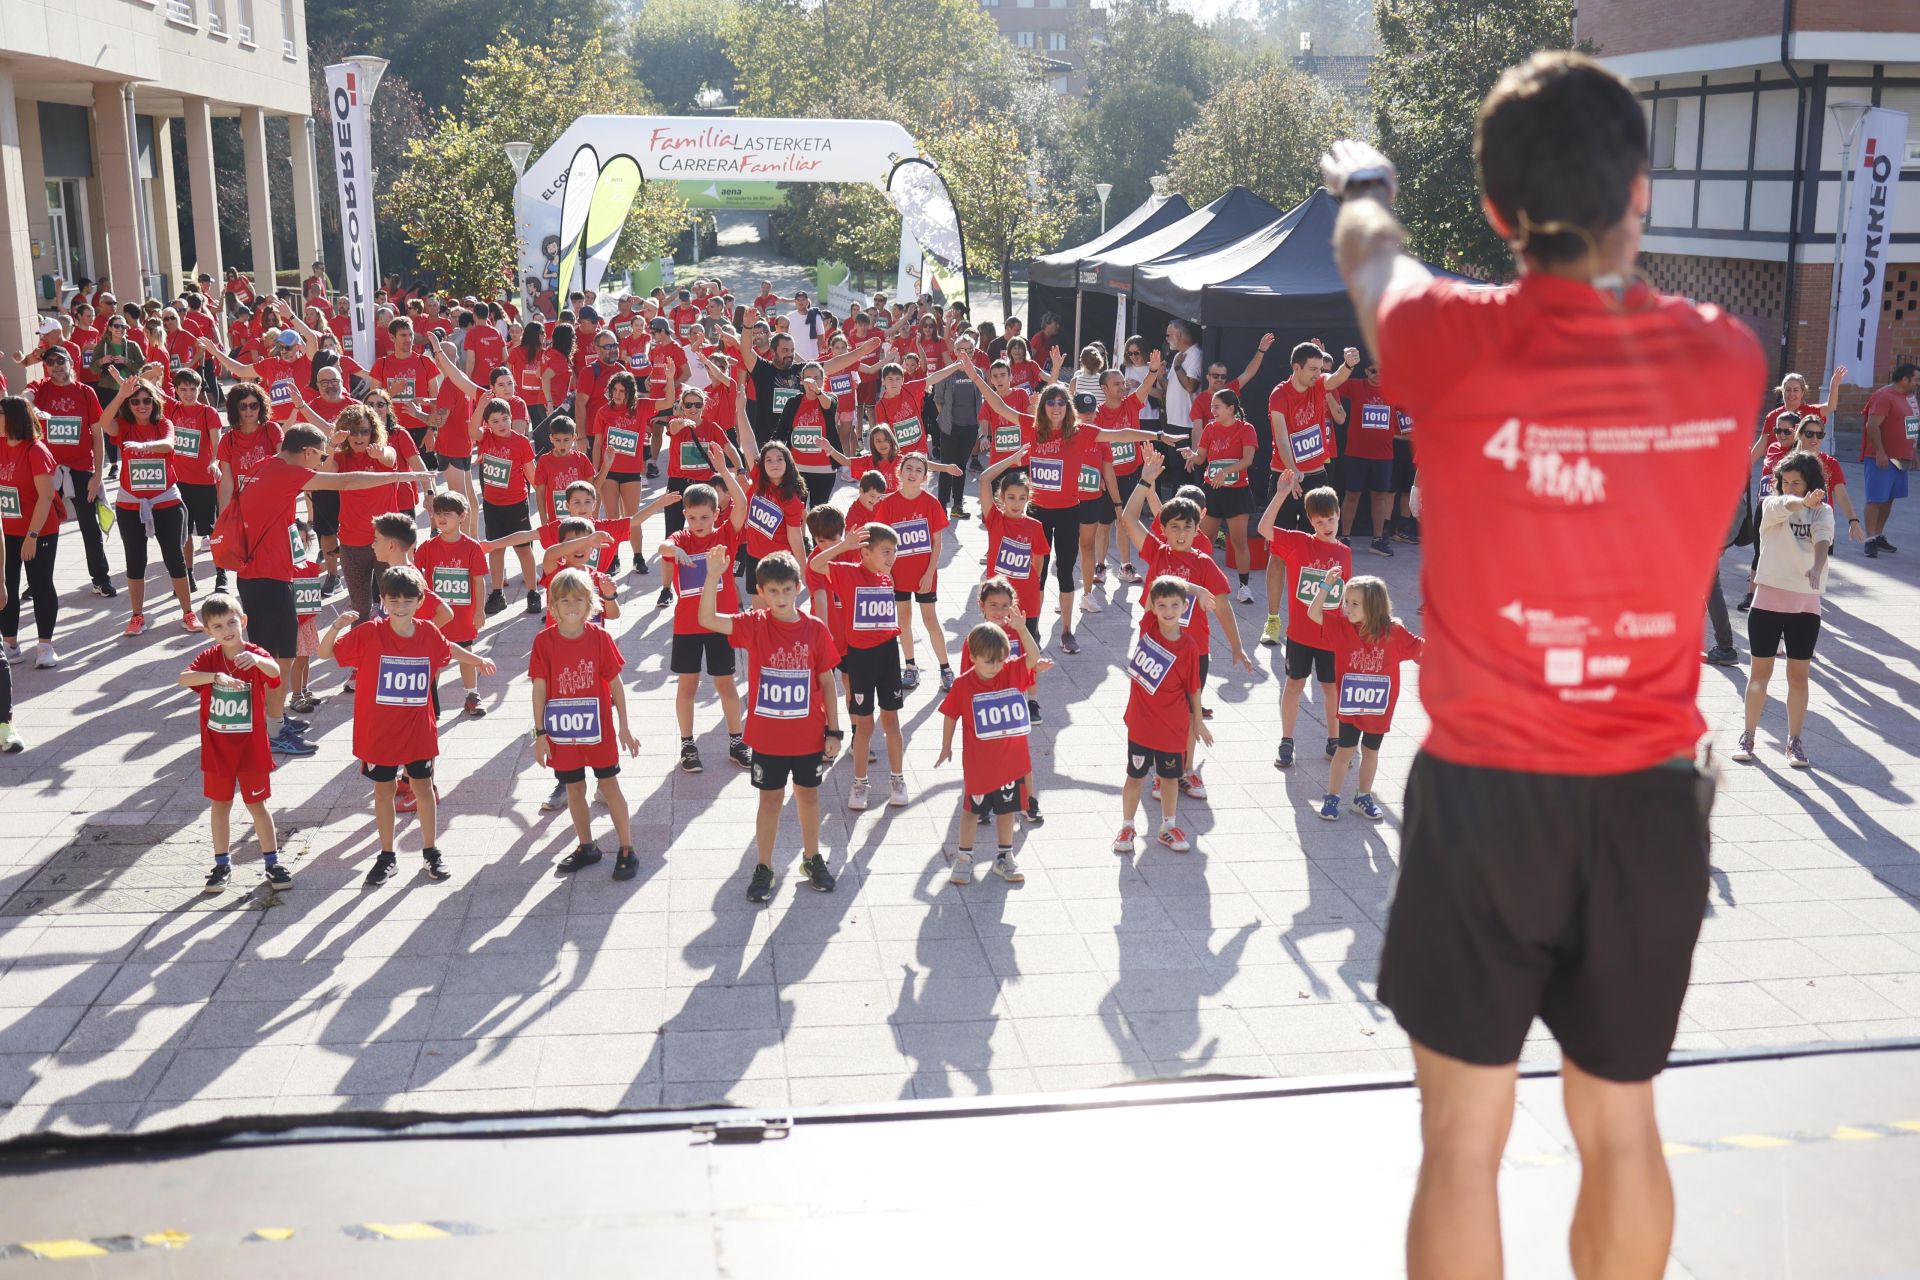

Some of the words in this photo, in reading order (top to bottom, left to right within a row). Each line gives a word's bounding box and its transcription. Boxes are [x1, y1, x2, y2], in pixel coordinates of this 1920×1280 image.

[335, 86, 363, 272] CORREO
[541, 188, 557, 201] EL
[721, 188, 742, 196] aena
[833, 379, 851, 390] 1005
[1364, 411, 1388, 422] 1010
[49, 424, 78, 437] 2031
[896, 425, 920, 440] 2026
[996, 433, 1020, 444] 2026
[608, 434, 635, 448] 2029
[1294, 433, 1321, 452] 1007
[1111, 443, 1133, 457] 2011
[131, 467, 163, 481] 2029
[483, 462, 507, 479] 2031
[1031, 467, 1060, 481] 1008
[751, 505, 778, 529] 1008
[895, 529, 928, 546] 1009
[1000, 549, 1031, 568] 1007
[434, 578, 469, 594] 2039
[1299, 579, 1340, 598] 204
[296, 589, 321, 603] 202
[859, 600, 894, 617] 1008
[1133, 645, 1164, 680] 1008
[382, 671, 427, 691] 1010
[761, 682, 806, 703] 1010
[1344, 686, 1386, 704] 1007
[208, 695, 249, 717] 2004
[977, 702, 1025, 726] 1010
[548, 712, 594, 732] 1007
